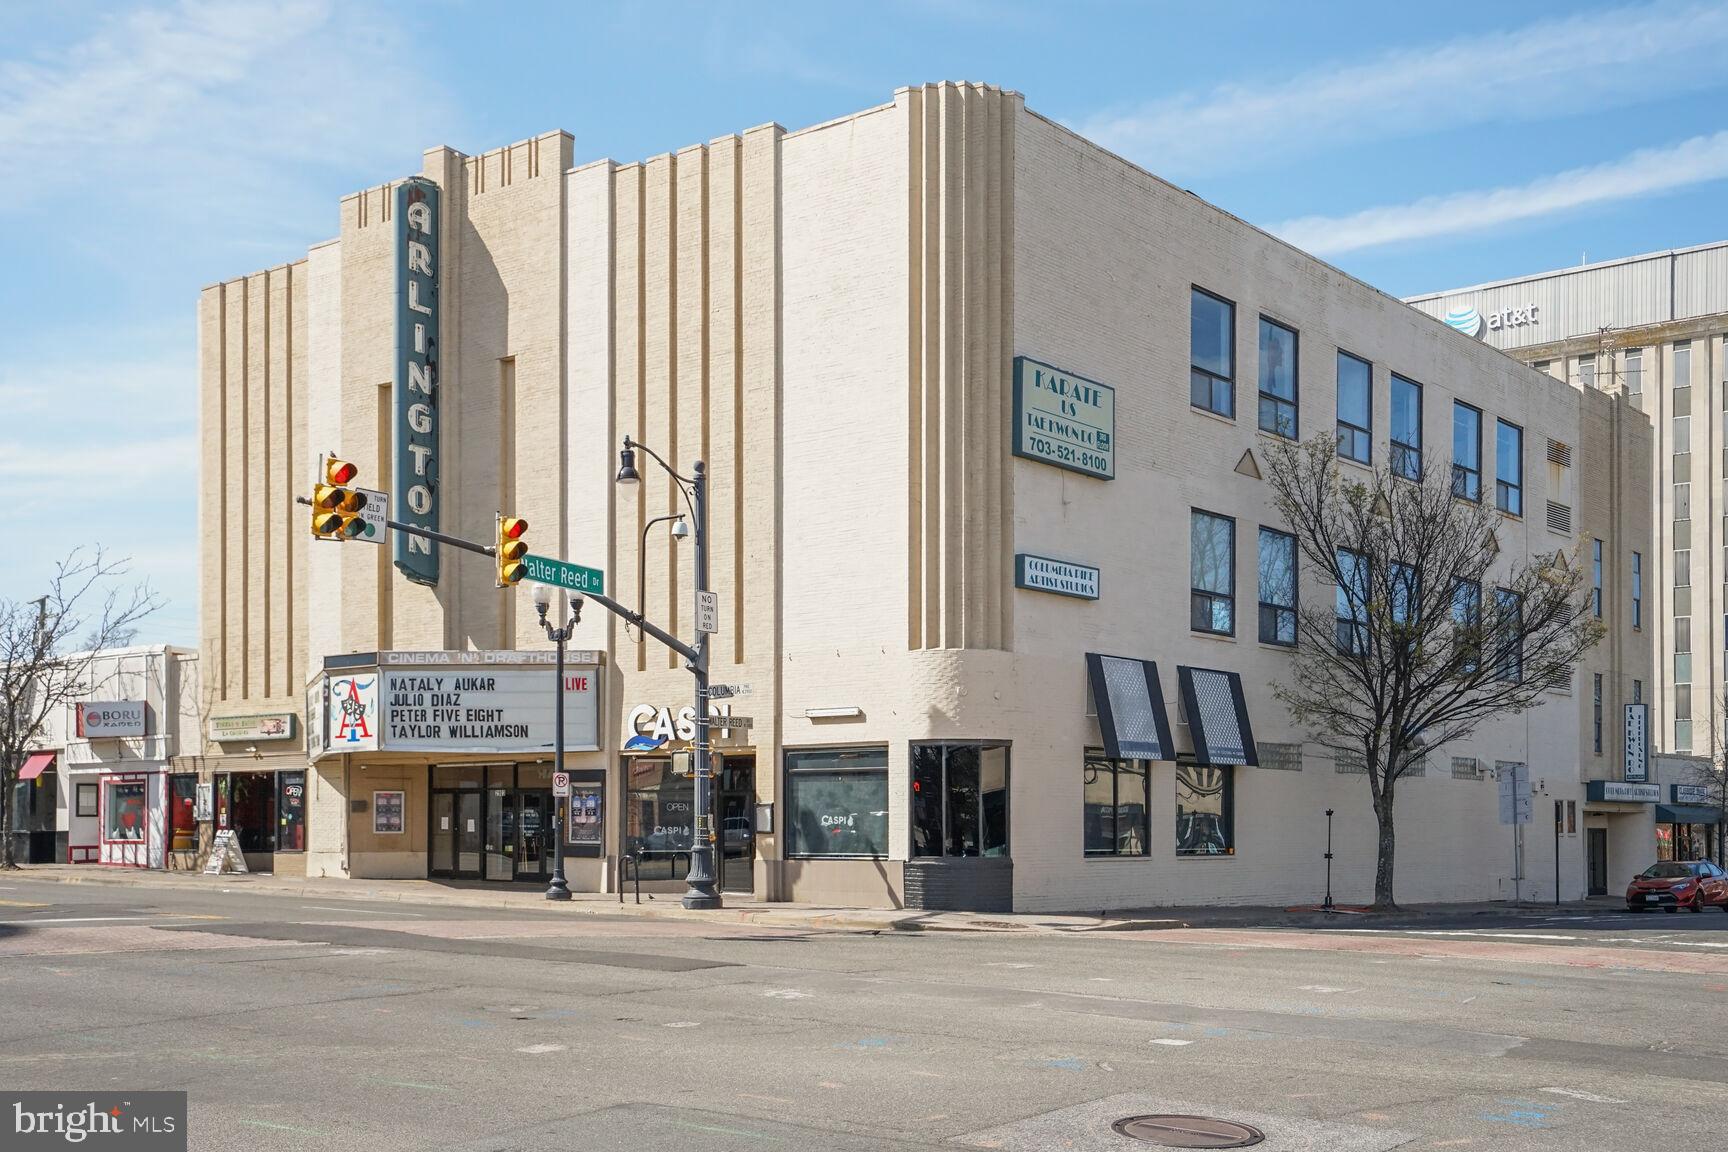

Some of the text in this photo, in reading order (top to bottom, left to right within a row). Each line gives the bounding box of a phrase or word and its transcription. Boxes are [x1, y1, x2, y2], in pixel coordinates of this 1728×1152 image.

[1488, 304, 1537, 328] at&t
[407, 201, 434, 555] ARLINGTON
[1035, 369, 1102, 409] KARATE
[1061, 400, 1076, 417] US
[1029, 436, 1107, 471] 703-521-8100
[374, 495, 386, 503] TURN
[362, 502, 381, 513] IELD
[367, 513, 385, 522] GREEN
[1029, 560, 1073, 578] COLUMBIA
[560, 566, 588, 589] Reed
[592, 577, 600, 587] Dr
[1029, 574, 1095, 595] ARTIST STUDIOS
[701, 594, 712, 604] NO
[701, 604, 714, 612] TURN
[702, 622, 712, 630] RED
[387, 653, 449, 664] CINEMA
[390, 677, 495, 691] NATALY AUKAR
[565, 677, 588, 690] LIVE
[708, 685, 741, 696] COLUMBIA
[390, 693, 461, 707] JULIO DIAZ
[102, 710, 141, 720] BORU
[391, 708, 504, 722] PETER FIVE EIGHT
[729, 717, 743, 728] REED
[391, 724, 529, 738] TAYLOR WILLIAMSON
[666, 802, 689, 811] OPEN
[821, 814, 847, 825] CASPI
[653, 825, 682, 835] CASPI
